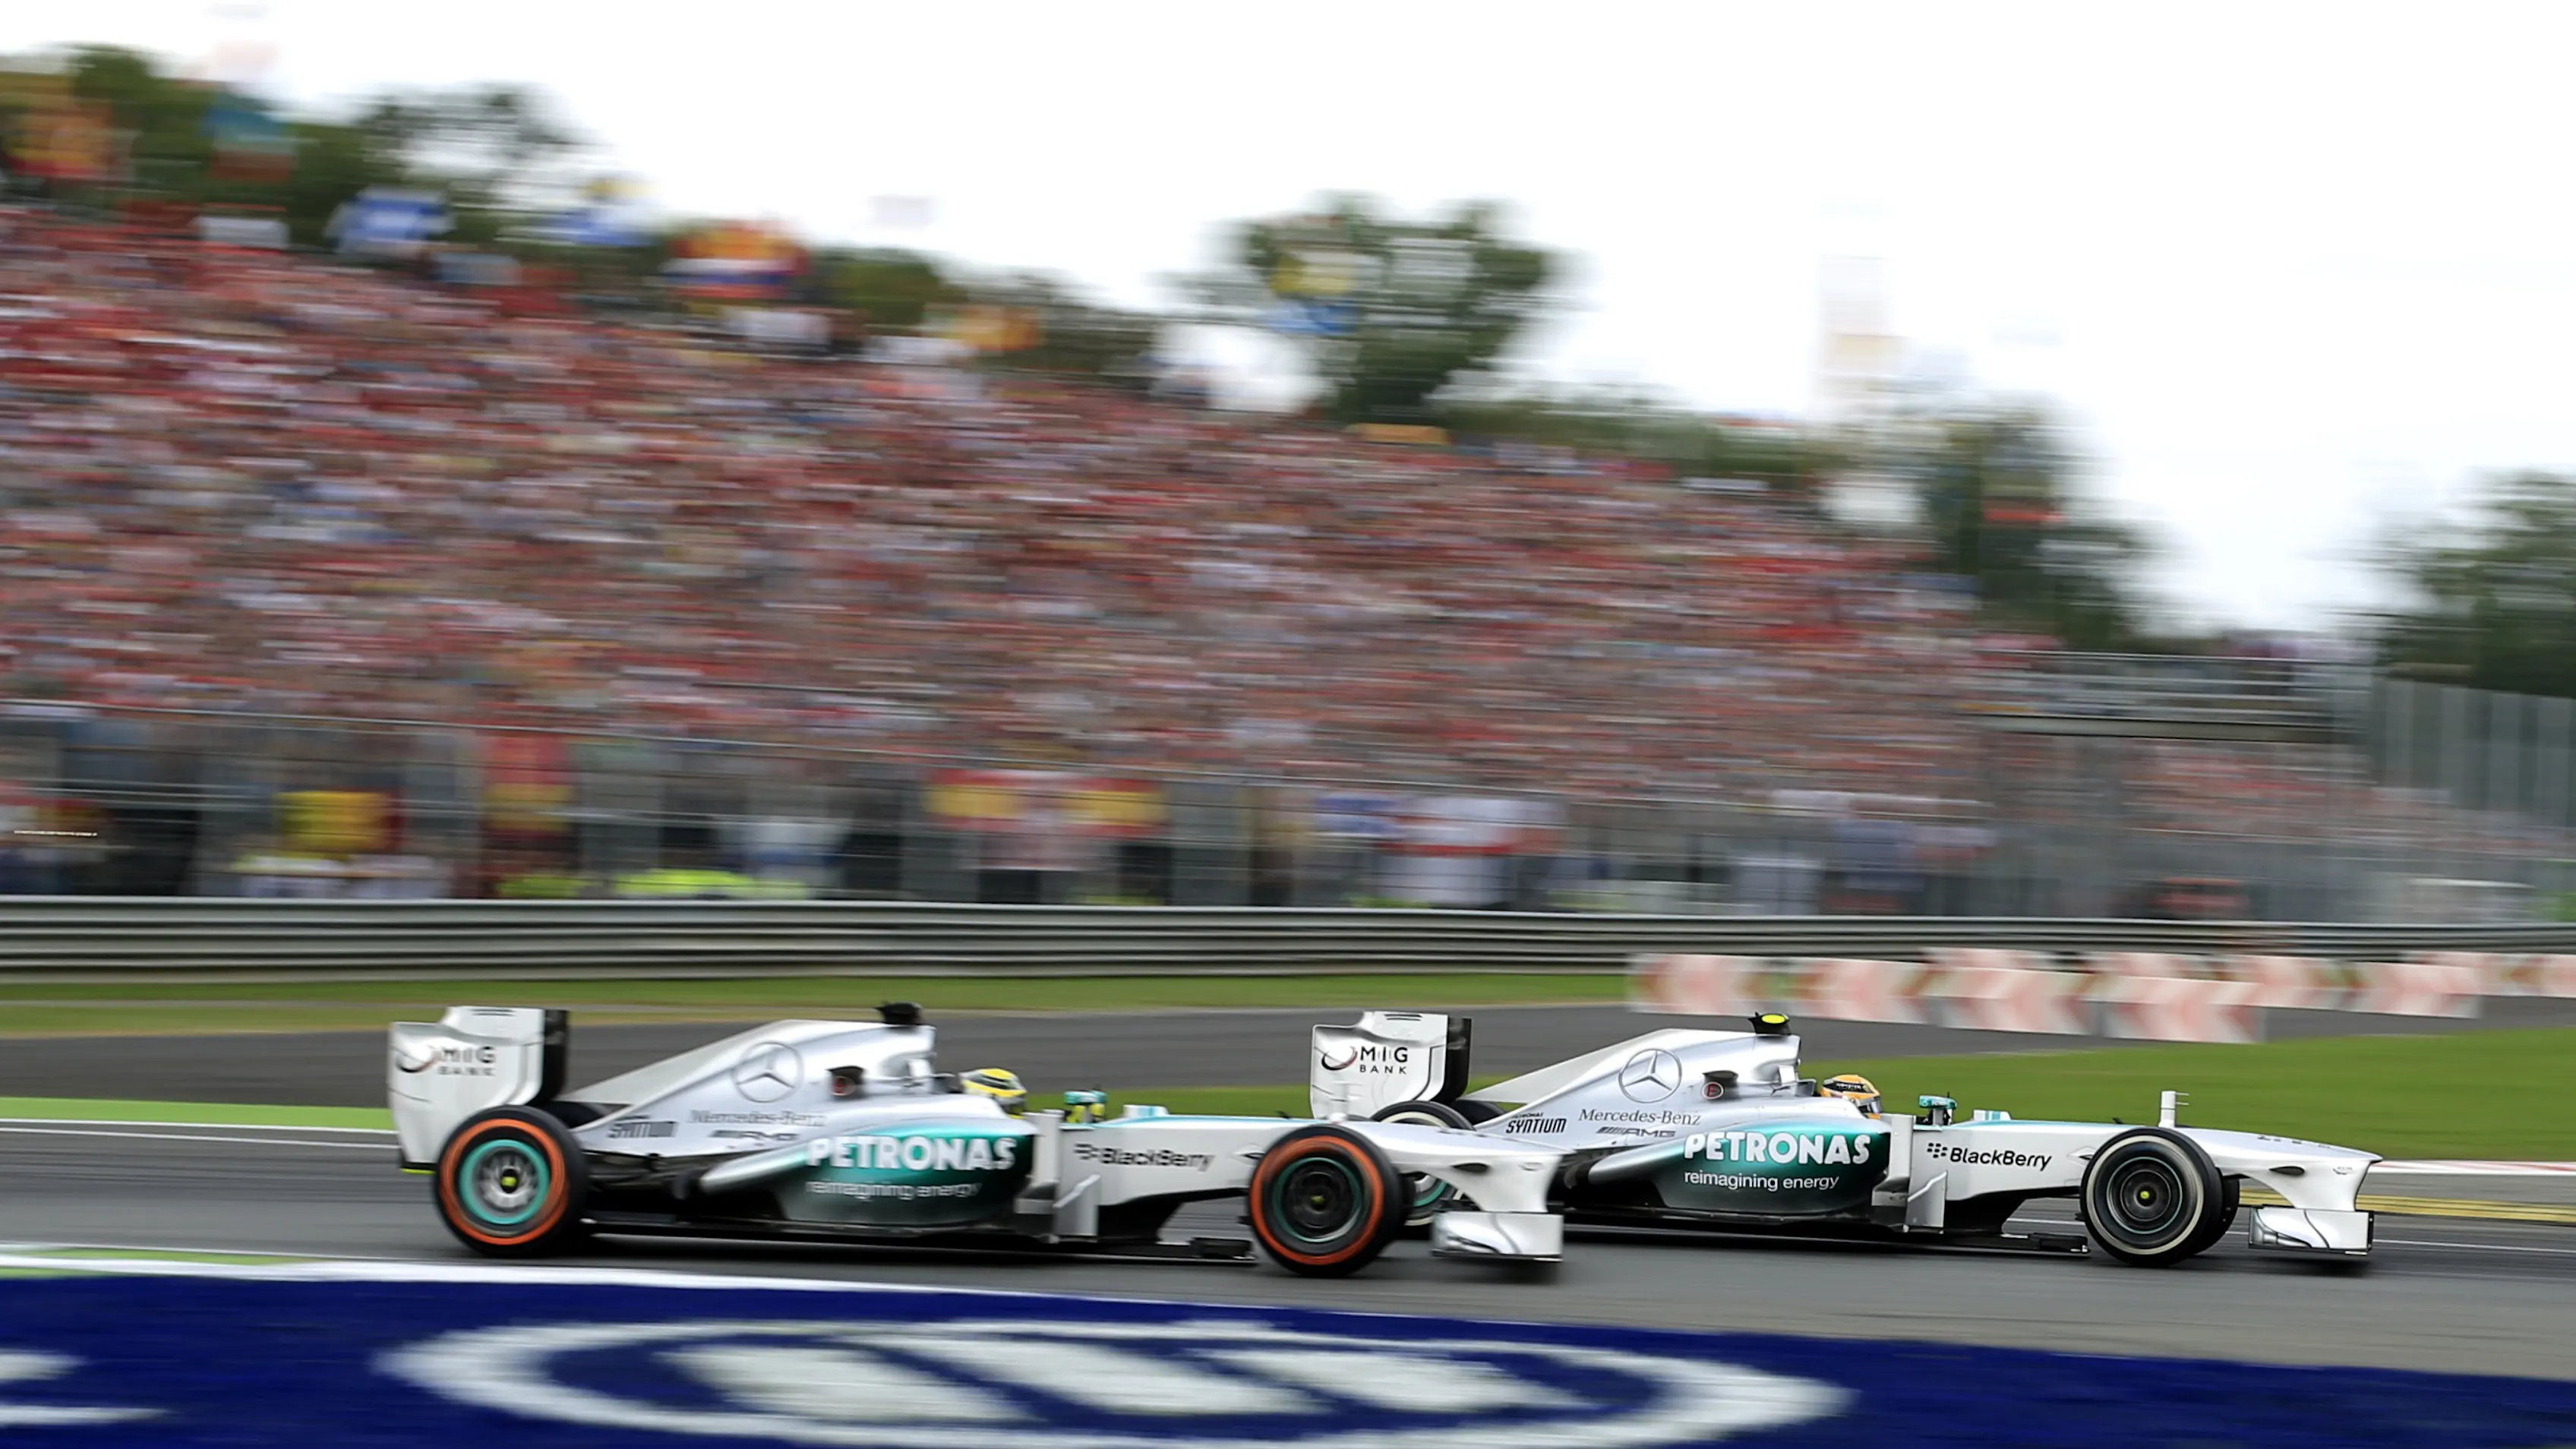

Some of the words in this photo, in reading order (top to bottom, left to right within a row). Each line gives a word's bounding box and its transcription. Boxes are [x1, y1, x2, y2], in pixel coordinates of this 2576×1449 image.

[441, 1046, 497, 1063] MIG
[1360, 1046, 1408, 1063] MIG
[1359, 1065, 1406, 1075] BANK
[1506, 1119, 1567, 1133] SYNTIUM
[1578, 1109, 1701, 1126] Mercedes-Benz
[1625, 1128, 1676, 1138] AMG
[807, 1135, 1018, 1171] PETRONAS
[1684, 1132, 1871, 1165] PETRONAS
[1101, 1148, 1215, 1171] BlackBerry
[1950, 1148, 2052, 1172] BlackBerry
[1684, 1170, 1779, 1192] reimagining
[1782, 1176, 1840, 1191] energy
